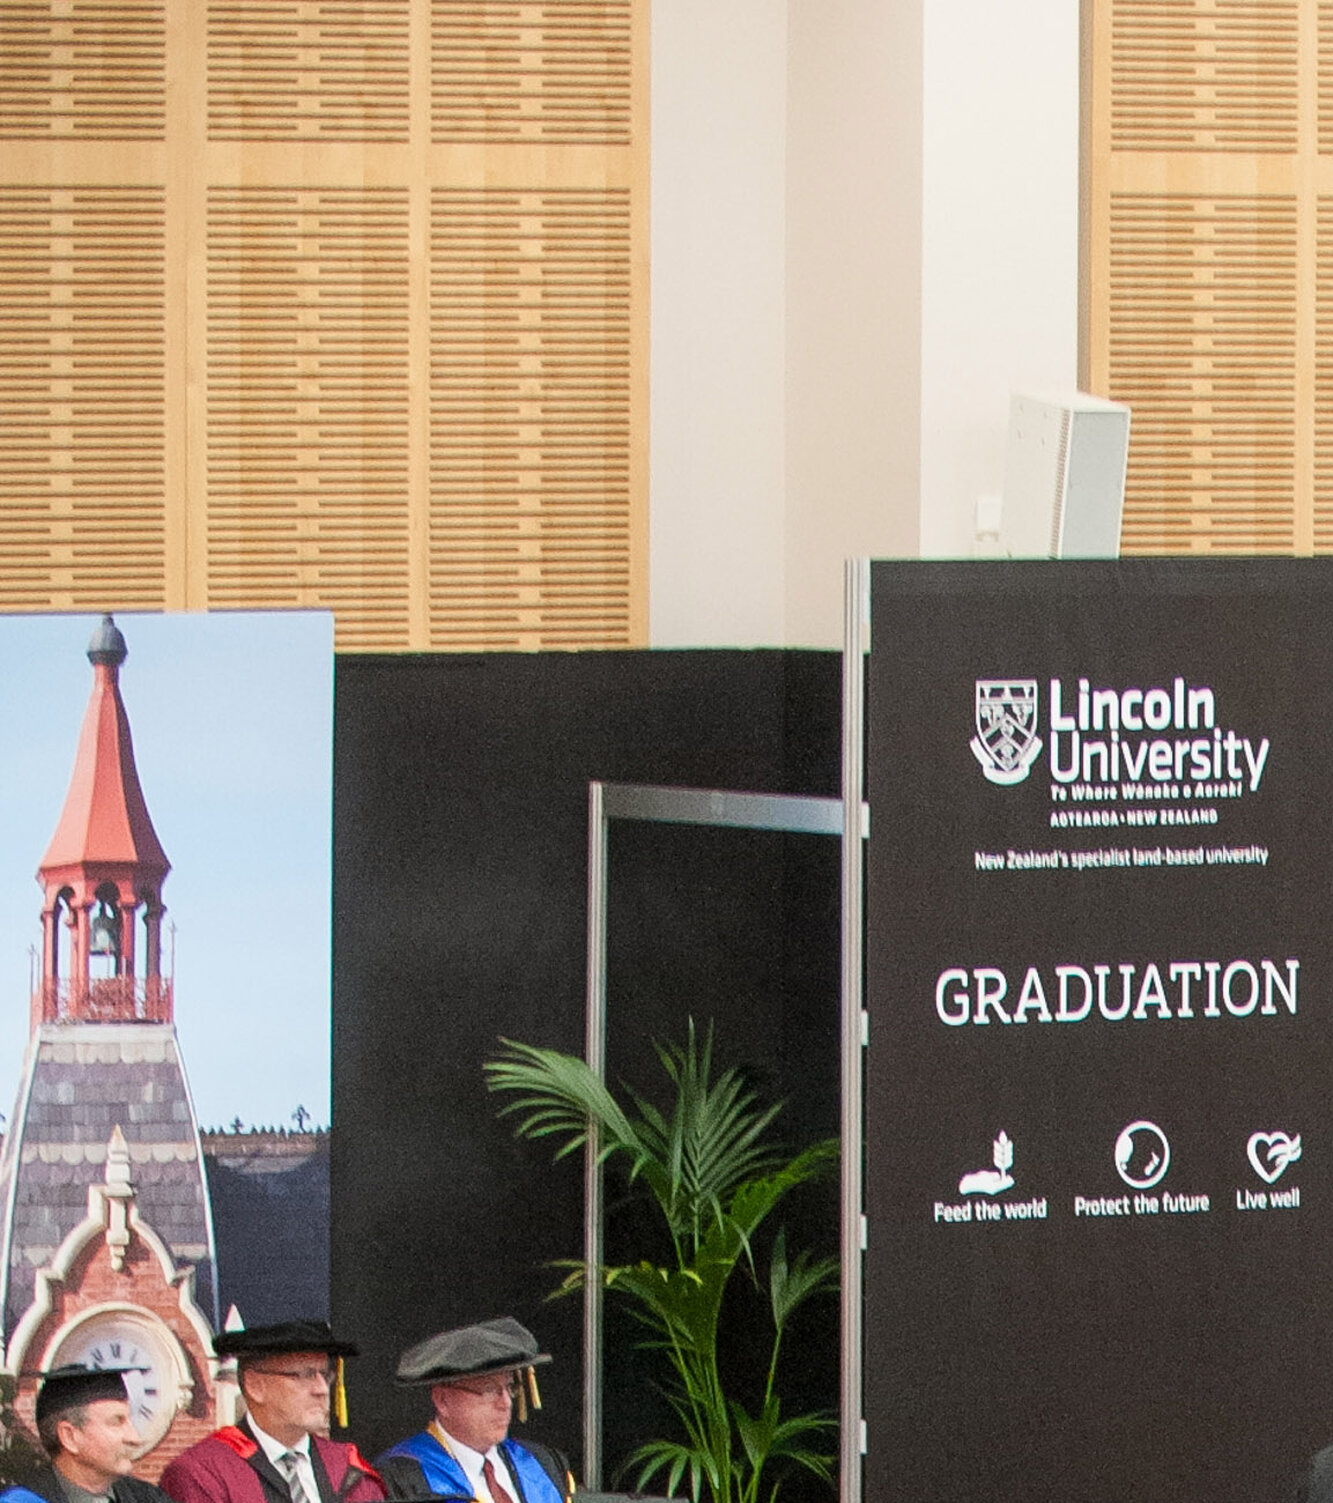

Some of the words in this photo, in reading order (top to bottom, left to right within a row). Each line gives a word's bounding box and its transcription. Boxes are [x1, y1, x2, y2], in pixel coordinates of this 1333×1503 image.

[1050, 677, 1215, 731] Lincoln
[1050, 727, 1270, 792] University
[1051, 784, 1067, 801] Te
[1160, 807, 1218, 826] ZEALAND
[974, 851, 1005, 871] New
[1007, 849, 1069, 870] Zealand's
[1071, 847, 1131, 871] specialist
[1133, 846, 1204, 867] land-based
[1206, 845, 1269, 866] university
[935, 958, 1300, 1027] GRADUATION
[934, 1200, 972, 1223] Feed
[975, 1199, 1002, 1222] the
[1004, 1197, 1048, 1220] world
[1074, 1195, 1131, 1217] Protect
[1134, 1193, 1160, 1215] the
[1162, 1191, 1210, 1214] future
[1236, 1188, 1267, 1210] Live
[1269, 1186, 1301, 1209] well
